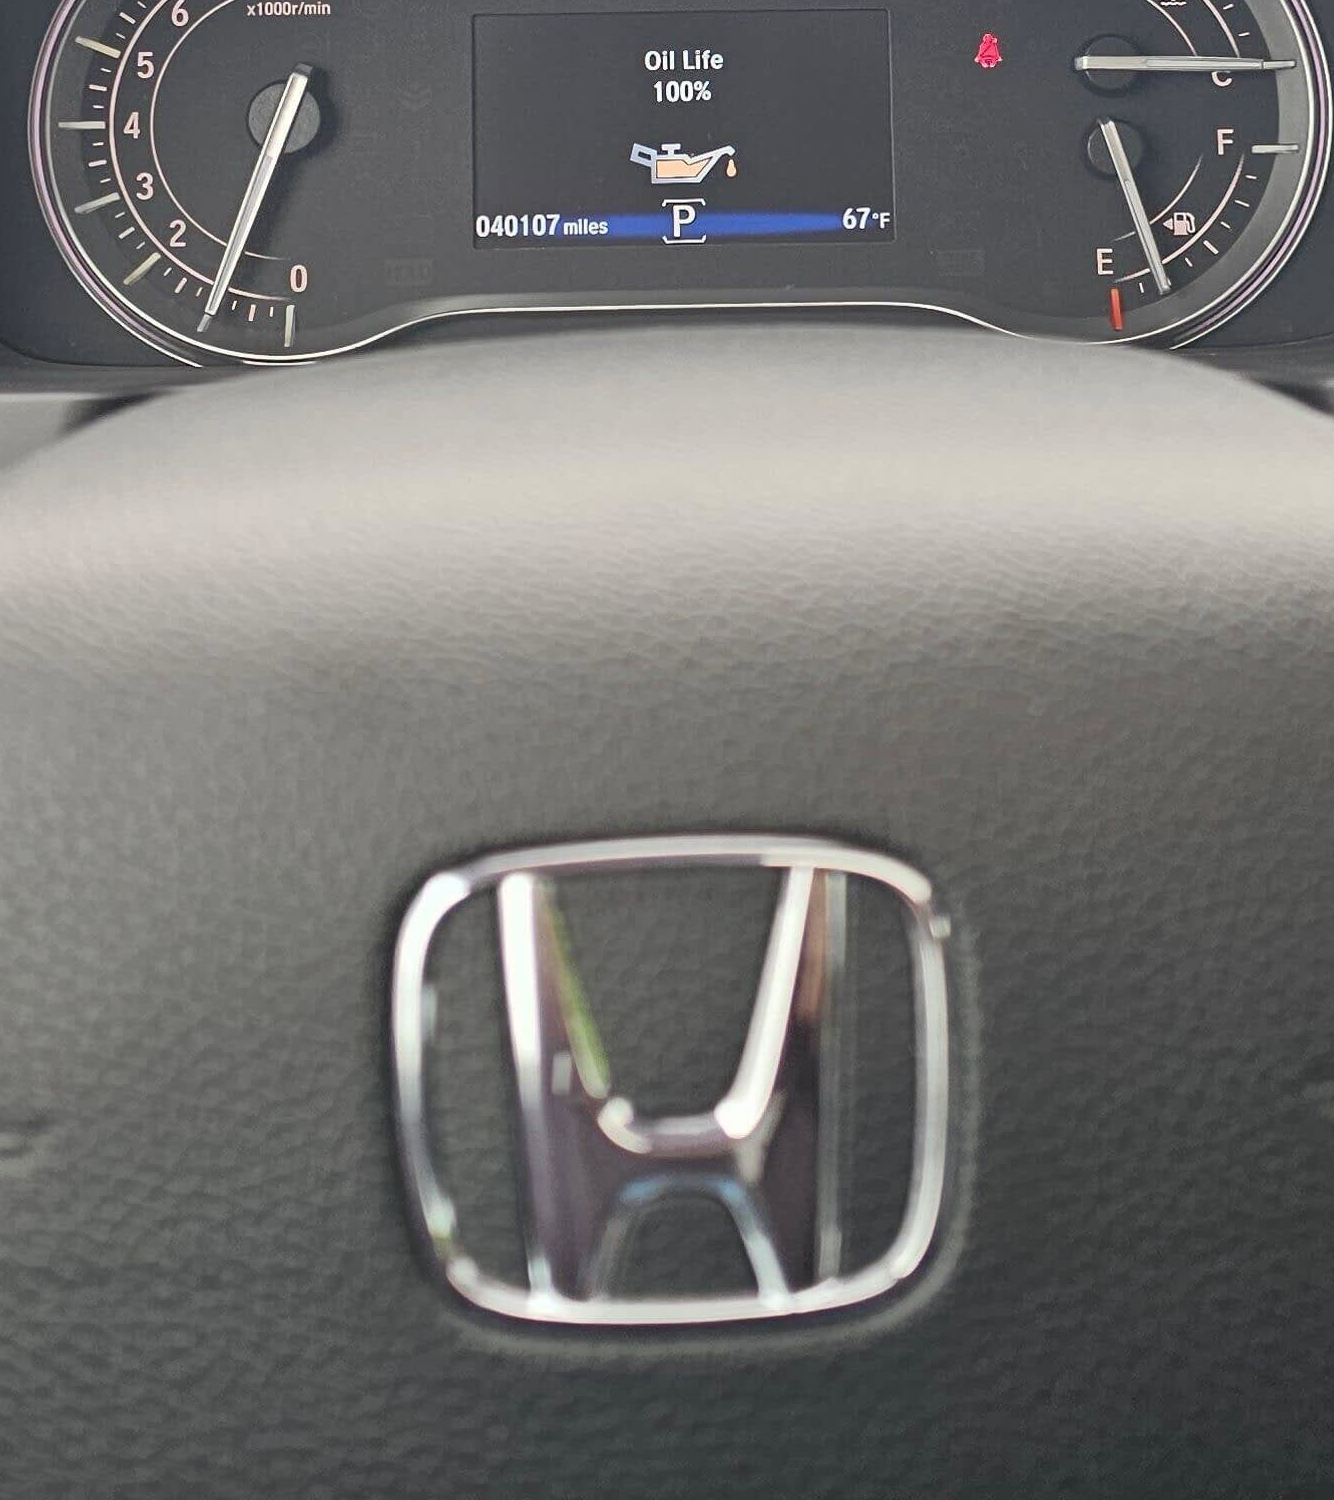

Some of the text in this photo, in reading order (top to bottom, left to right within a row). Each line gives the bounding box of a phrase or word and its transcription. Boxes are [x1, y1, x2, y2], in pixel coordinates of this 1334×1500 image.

[171, 0, 190, 27] 6
[246, 0, 332, 18] x1000r/min
[136, 51, 156, 79] 5
[644, 48, 725, 72] Oil Life
[652, 80, 712, 103] 100%
[122, 112, 141, 140] 4
[1216, 128, 1234, 156] F
[135, 172, 155, 201] 3
[168, 219, 187, 248] 2
[475, 213, 609, 239] 040107 miles
[671, 204, 697, 238] P
[1096, 248, 1114, 276] E
[289, 264, 309, 293] 0
